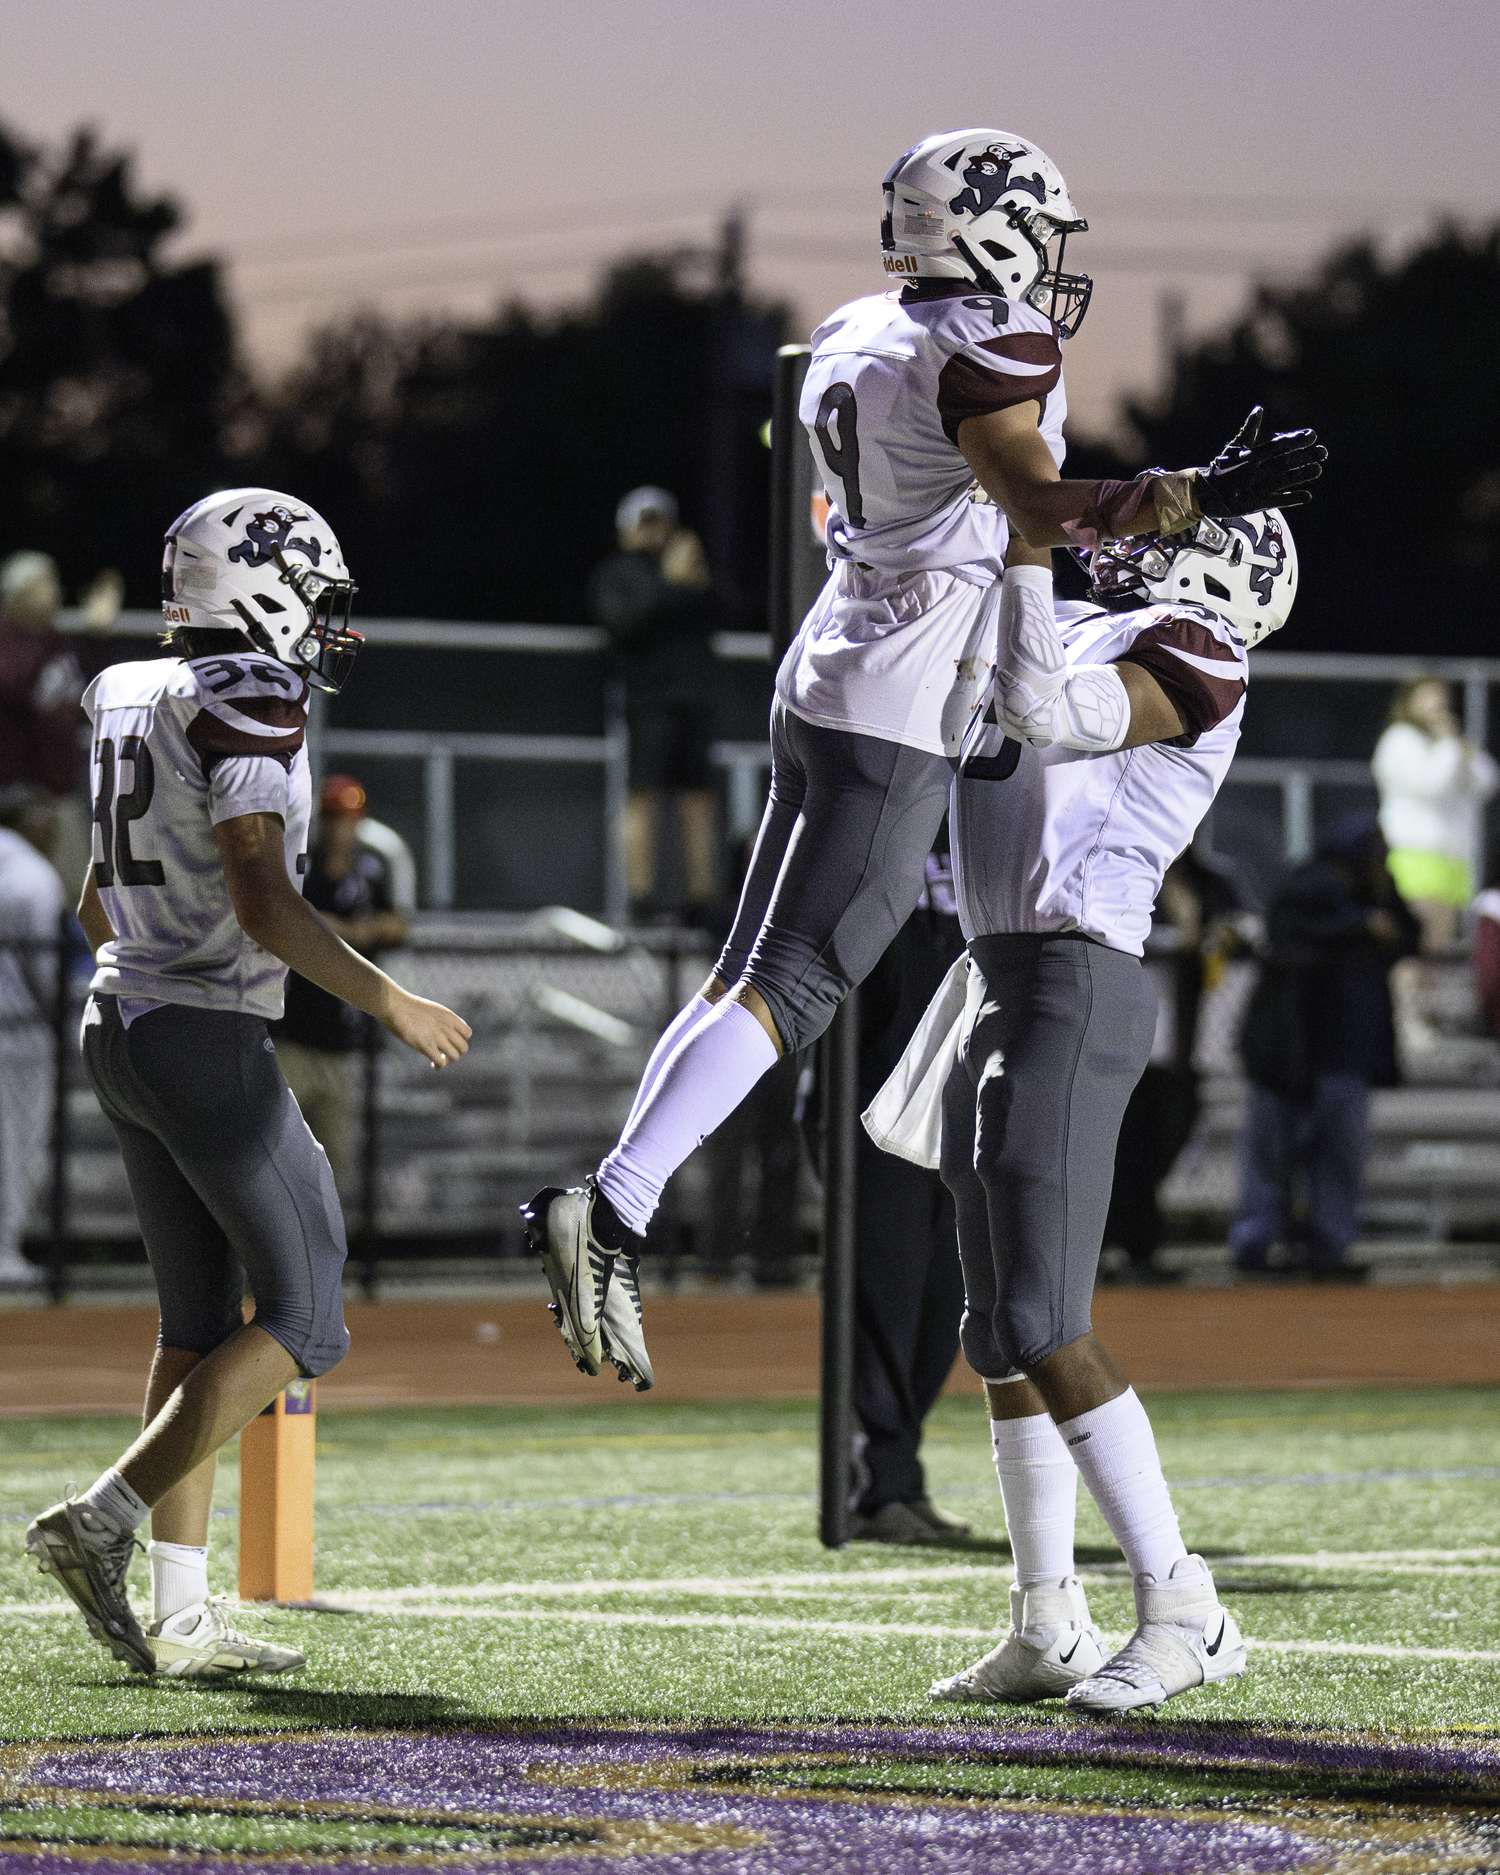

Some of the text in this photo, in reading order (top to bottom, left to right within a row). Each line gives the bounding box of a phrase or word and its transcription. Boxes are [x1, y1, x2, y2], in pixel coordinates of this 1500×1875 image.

[962, 297, 1010, 328] 9
[815, 382, 867, 530] 9
[94, 735, 167, 889] 32
